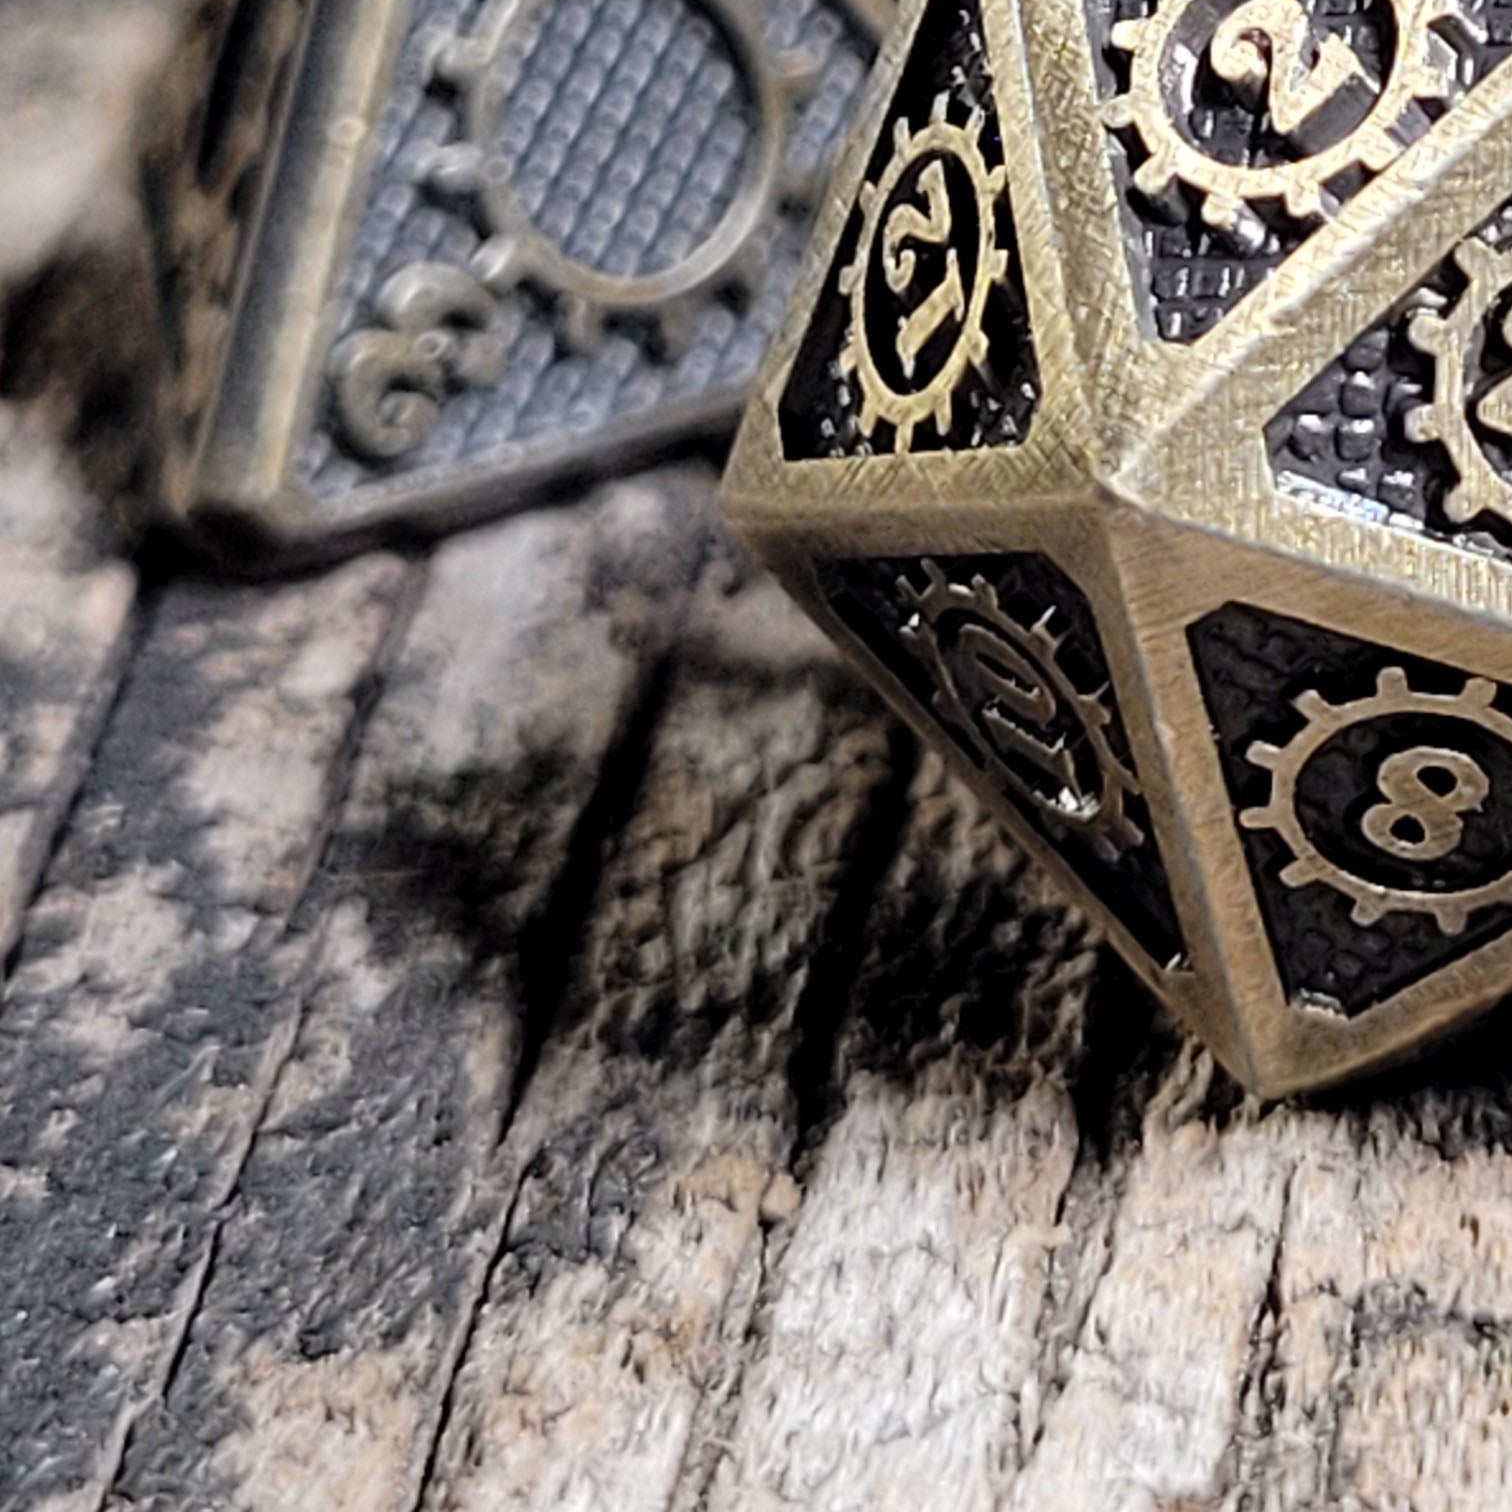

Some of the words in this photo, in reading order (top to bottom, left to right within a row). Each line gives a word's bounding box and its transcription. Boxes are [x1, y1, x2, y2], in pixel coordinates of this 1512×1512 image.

[330, 261, 504, 457] 3
[882, 158, 966, 382] 12
[1359, 745, 1491, 863] 8
